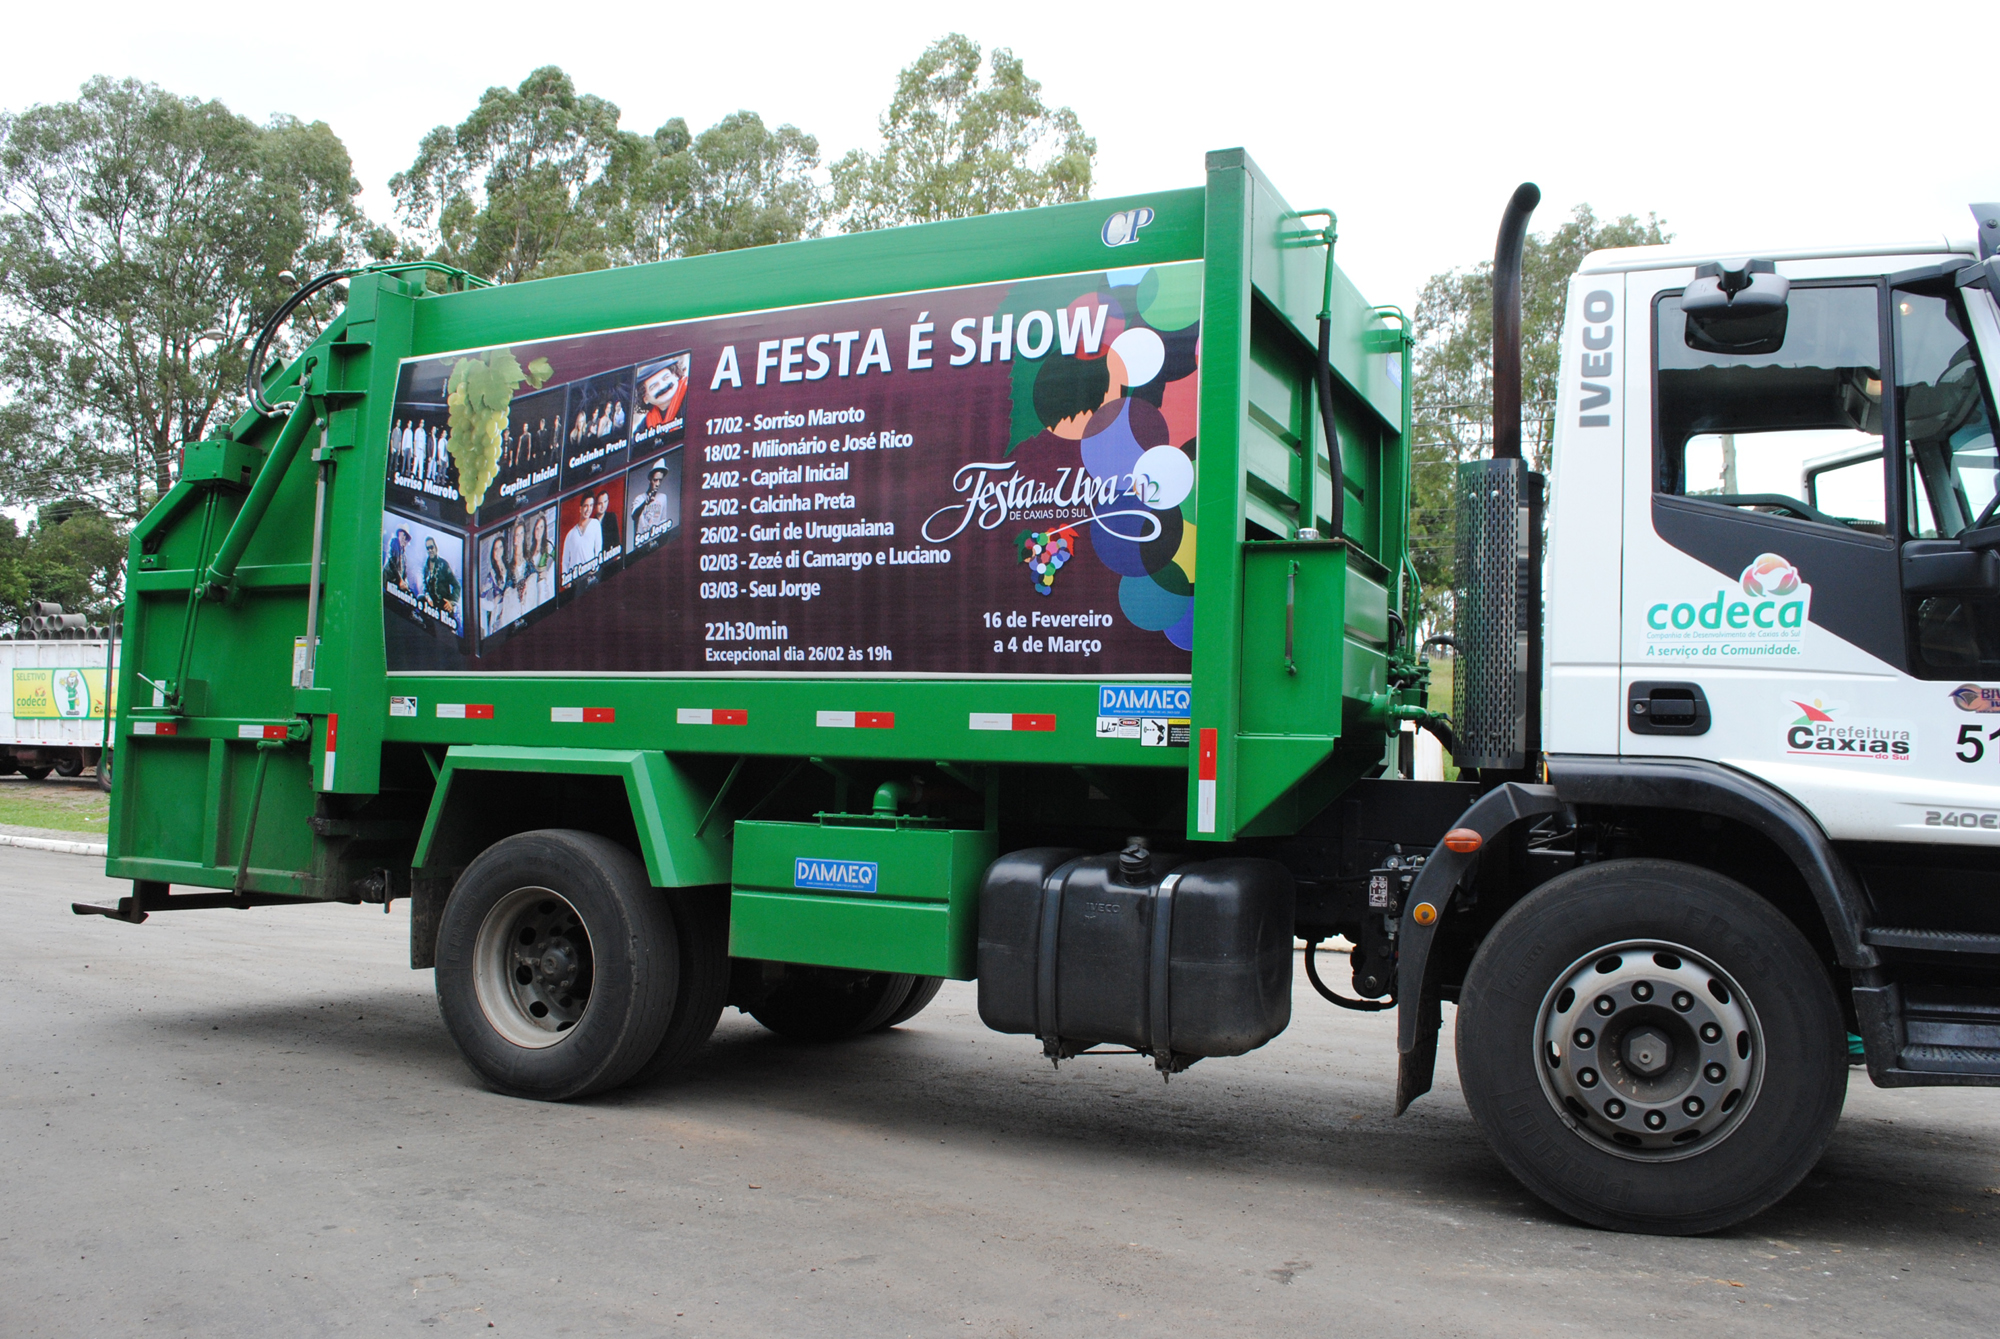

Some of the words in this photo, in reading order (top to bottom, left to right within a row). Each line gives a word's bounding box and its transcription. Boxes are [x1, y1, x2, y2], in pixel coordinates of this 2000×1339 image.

[710, 346, 742, 390] A
[756, 328, 891, 385] FESTA
[907, 311, 934, 370] É
[950, 304, 1109, 367] SHOW
[1579, 289, 1614, 428] IVECO
[705, 416, 742, 435] 17/02
[753, 411, 805, 431] Sorriso
[808, 407, 865, 426] Maroto
[569, 447, 604, 469] Calcinha
[605, 438, 627, 454] Preta
[704, 443, 741, 462] 18/02
[752, 436, 827, 458] Milionário
[829, 439, 840, 452] e
[842, 432, 876, 452] José
[880, 430, 913, 449] Rico
[394, 472, 423, 492] Sorriso
[424, 477, 459, 501] Maroto
[500, 476, 531, 497] Capital
[532, 463, 559, 485] Inicial
[702, 471, 740, 489] 24/02
[750, 465, 802, 489] Capital
[805, 462, 849, 482] Inicial
[701, 498, 739, 517] 25/02
[750, 495, 811, 514] Calcinha
[814, 493, 856, 510] Preta
[921, 461, 1034, 543] Festa
[1033, 482, 1054, 504] da
[1010, 511, 1021, 520] DE
[1023, 509, 1054, 520] CAXIAS
[1056, 509, 1069, 519] DO
[1071, 508, 1088, 518] SUL
[635, 532, 649, 546] Seu
[651, 520, 672, 537] Jorge
[701, 526, 739, 544] 26/02
[750, 523, 781, 542] Guri
[783, 522, 803, 540] de
[805, 518, 894, 542] Uruguaiana
[700, 554, 739, 572] 02/03
[749, 551, 783, 570] Zezé
[785, 550, 800, 568] di
[803, 550, 872, 571] Camargo
[876, 550, 886, 565] e
[889, 545, 951, 565] Luciano
[700, 582, 739, 599] 03/03
[749, 580, 776, 598] Seu
[779, 580, 821, 601] Jorge
[983, 611, 1002, 628] 16
[1006, 611, 1027, 628] de
[1032, 610, 1113, 628] Fevereiro
[1647, 590, 1804, 630] codeca
[705, 620, 788, 641] 22h30min
[1646, 631, 1682, 640] Companhia
[1683, 631, 1691, 639] de
[1693, 630, 1746, 639] Desenvolvimento
[1748, 630, 1756, 638] de
[1758, 630, 1779, 638] Caxias
[1781, 630, 1789, 638] do
[1791, 630, 1801, 638] Sul
[705, 647, 780, 665] Excepcional
[784, 647, 805, 661] dia
[808, 646, 844, 662] 26/02
[848, 646, 863, 661] às
[867, 645, 892, 661] 19h
[994, 640, 1004, 652] a
[1008, 636, 1018, 652] 4
[1022, 635, 1043, 652] de
[1048, 636, 1102, 656] Março
[1646, 645, 1655, 656] A
[1658, 645, 1698, 659] serviço
[1702, 645, 1717, 656] da
[1721, 644, 1801, 656] Comunidade.
[16, 673, 46, 681] SELETIVO
[16, 695, 47, 706] codeca
[1102, 690, 1191, 709] DAMAEQ
[1787, 726, 1910, 754] Caxias
[1816, 724, 1910, 741] Prefeitura
[1892, 753, 1910, 761] Sul
[1925, 811, 2000, 829] 240E
[798, 862, 873, 884] DAMAEQ
[1086, 902, 1120, 913] IVECO
